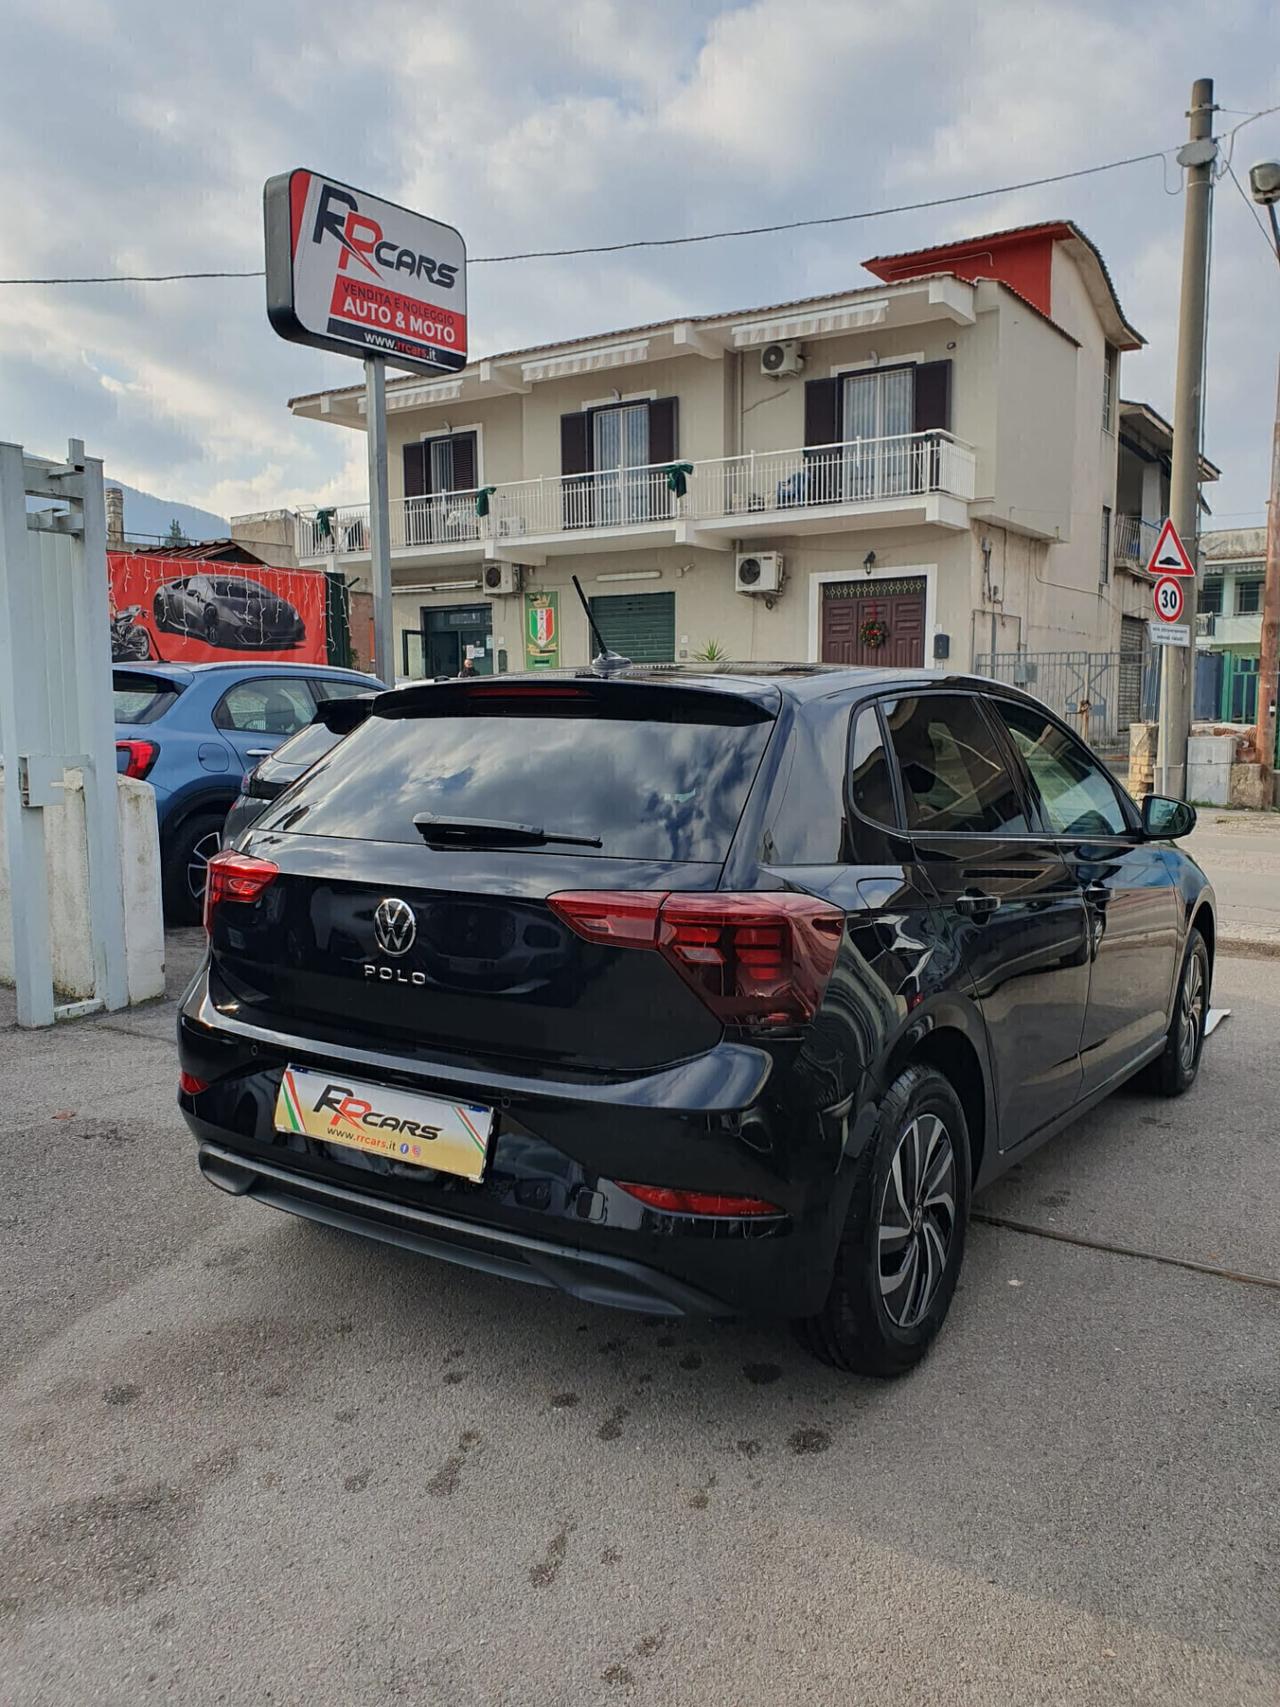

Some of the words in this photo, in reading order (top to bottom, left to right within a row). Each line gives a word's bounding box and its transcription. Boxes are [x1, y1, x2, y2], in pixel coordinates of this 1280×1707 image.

[342, 281, 391, 306] VENDITA
[394, 297, 400, 309] E
[403, 301, 455, 326] NOLEGGIO
[343, 296, 391, 324] AUTO
[395, 311, 405, 329] &
[410, 315, 456, 343] MOTO
[364, 332, 437, 361] www.rrcars.it
[1161, 590, 1177, 609] 30
[364, 965, 425, 985] POLO
[327, 1127, 396, 1151] www.rrcars.it
